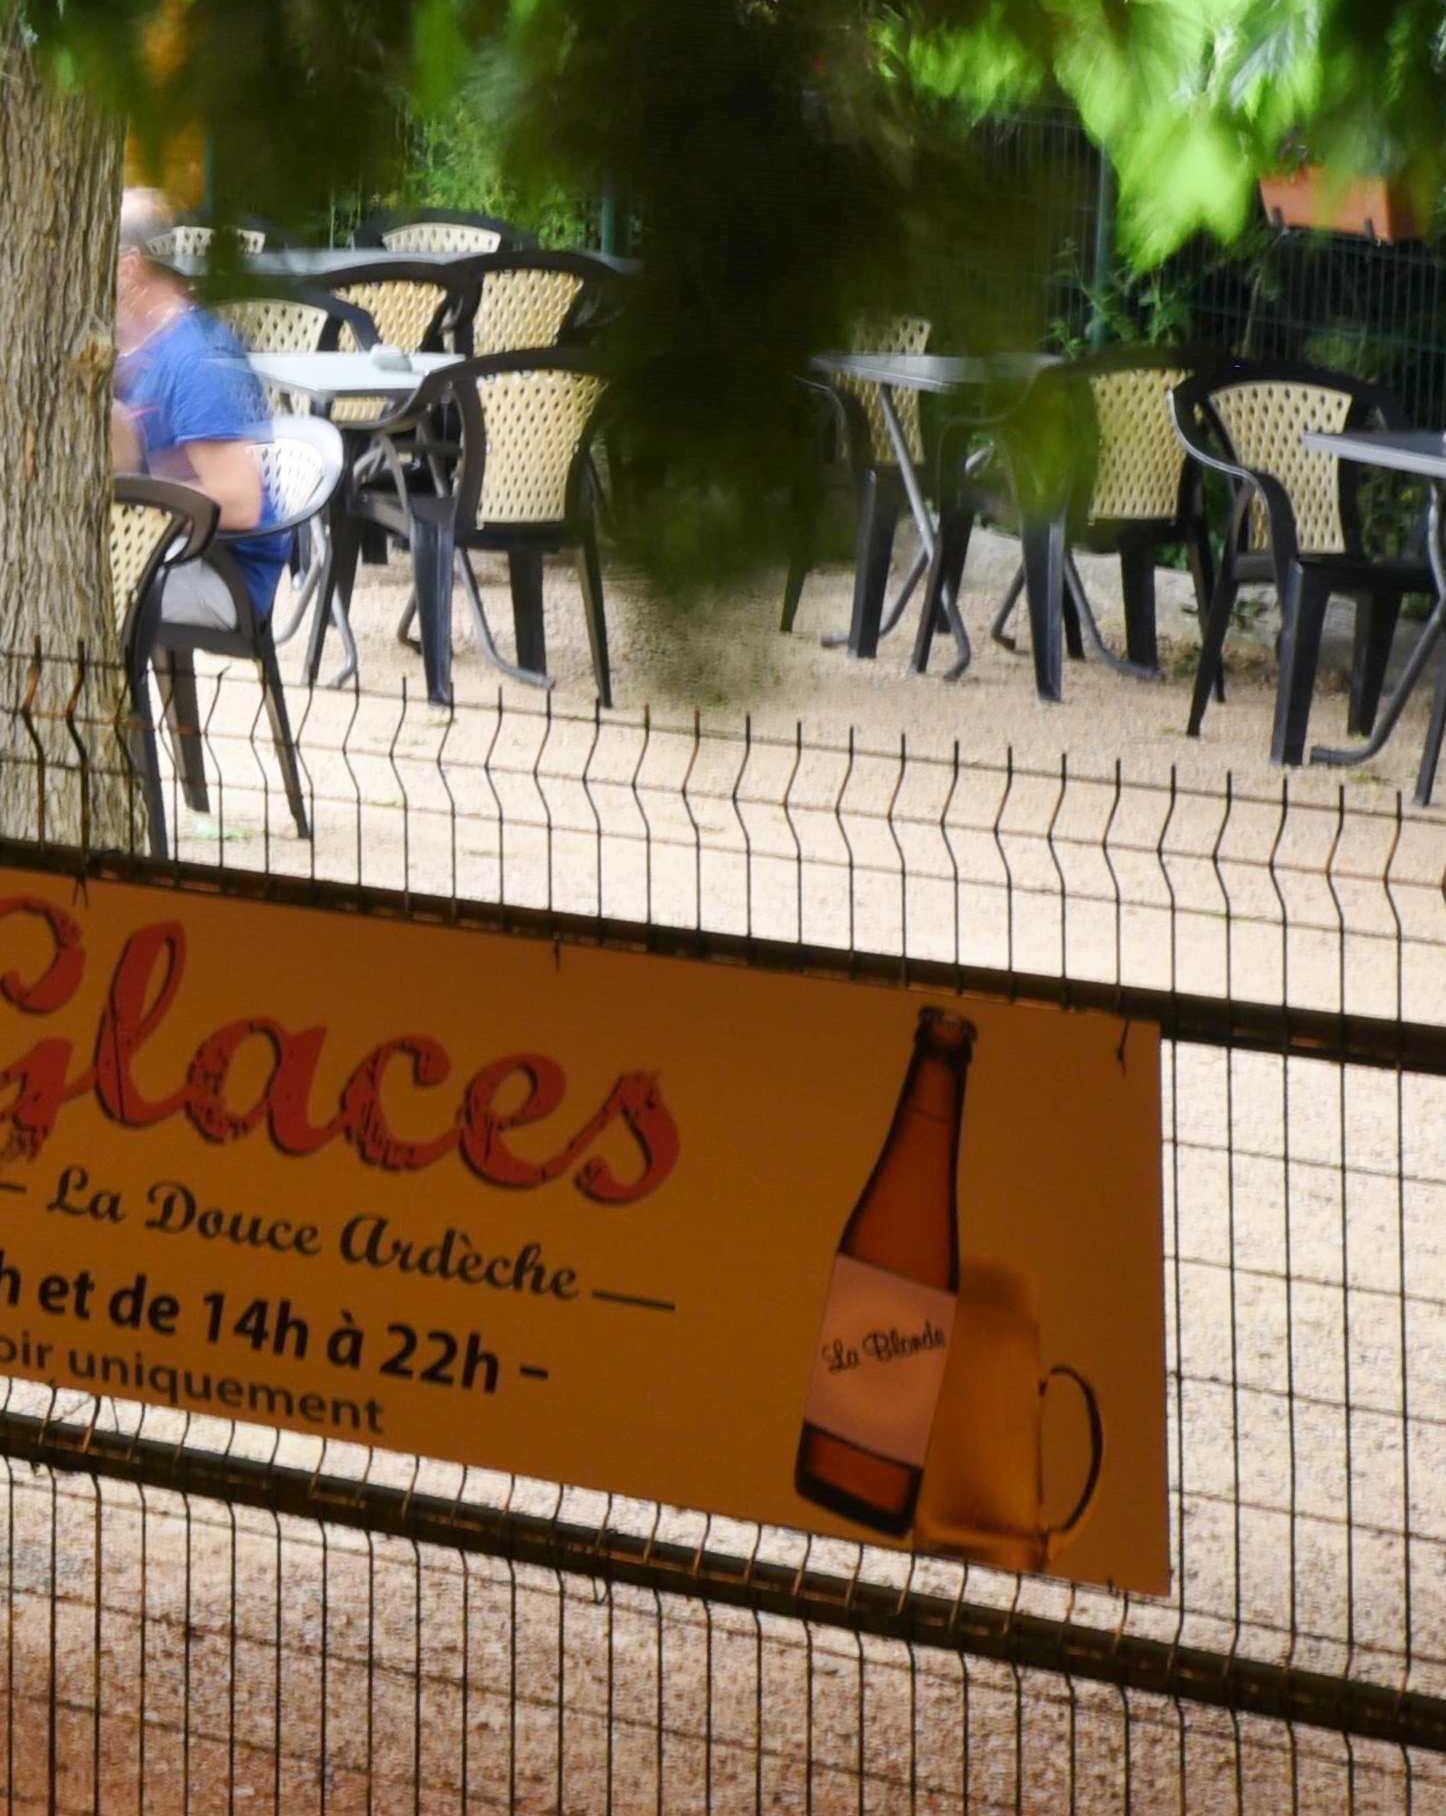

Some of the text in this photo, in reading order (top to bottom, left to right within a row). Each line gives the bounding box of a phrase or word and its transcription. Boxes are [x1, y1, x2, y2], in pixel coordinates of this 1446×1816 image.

[47, 1167, 579, 1301] La Douce Ardèche
[37, 1269, 95, 1320] et
[108, 1274, 180, 1335] de
[202, 1291, 310, 1361] 14h
[326, 1310, 365, 1370] à
[378, 1322, 501, 1395] 22h
[822, 1318, 946, 1376] La Blonde
[68, 1346, 384, 1435] uniquement
